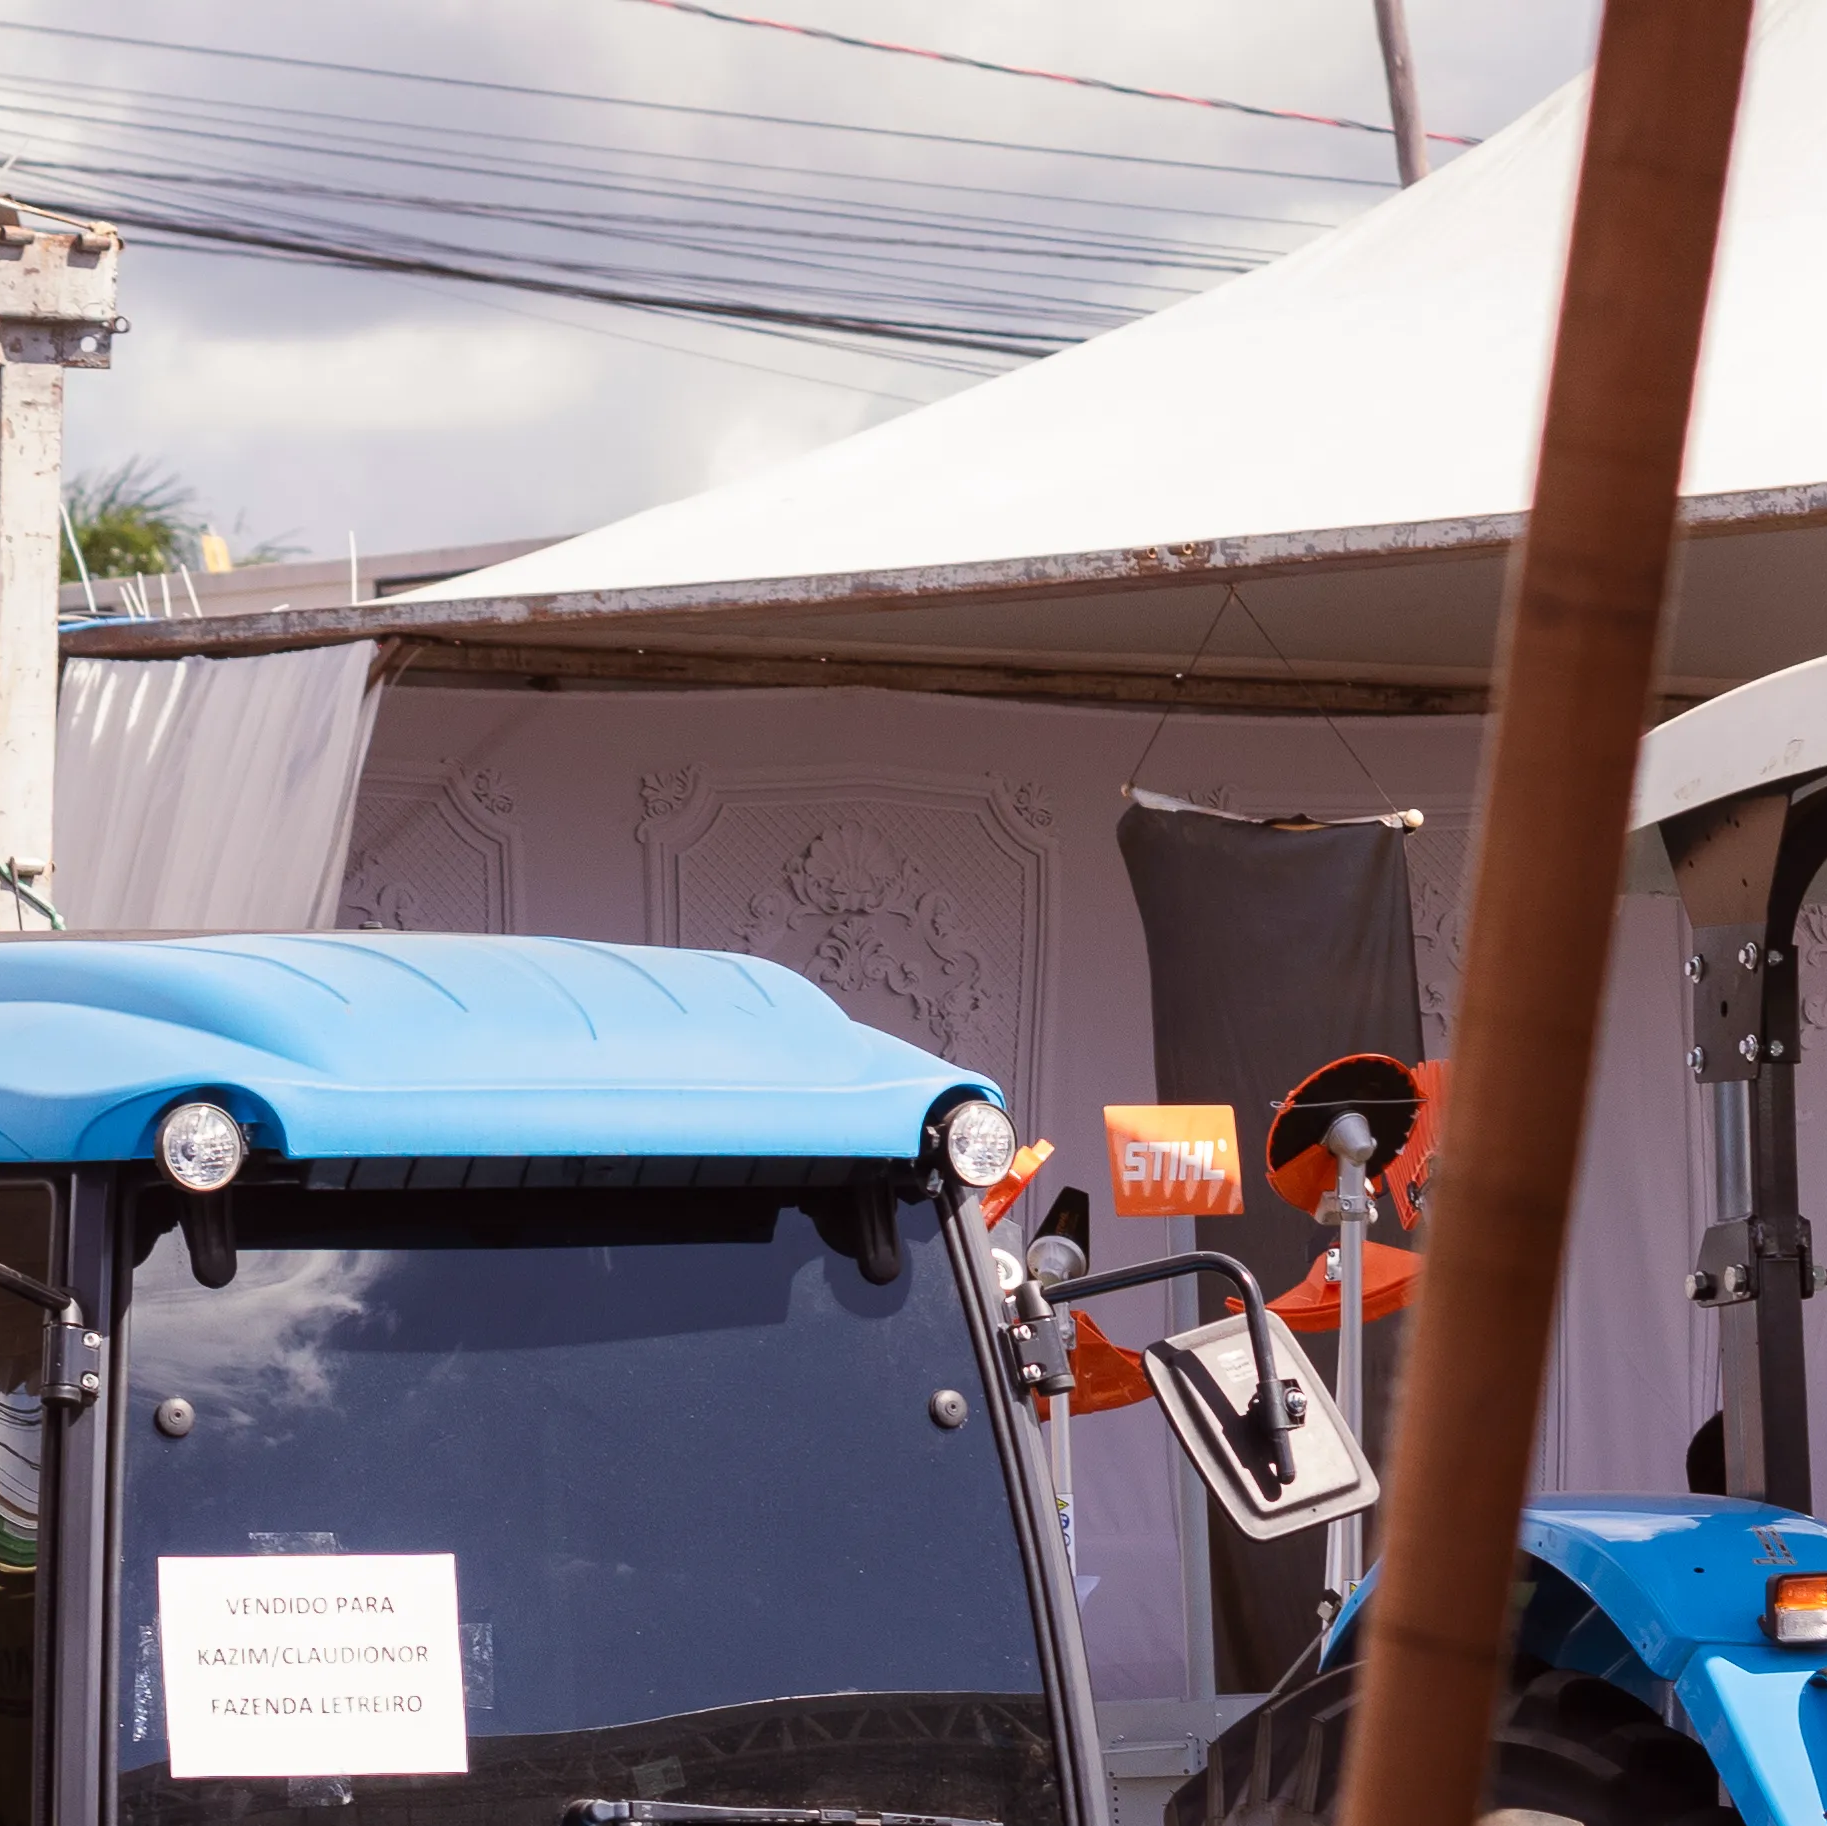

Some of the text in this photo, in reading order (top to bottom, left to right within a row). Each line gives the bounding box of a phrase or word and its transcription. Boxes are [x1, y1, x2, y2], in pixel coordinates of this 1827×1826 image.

[1123, 1140, 1225, 1181] STIHL
[226, 1596, 394, 1615] VENDIDO PARA
[197, 1646, 428, 1667] KAZIM/CLAUDIONOR
[212, 1695, 422, 1715] FAZENDA LETREIRO
